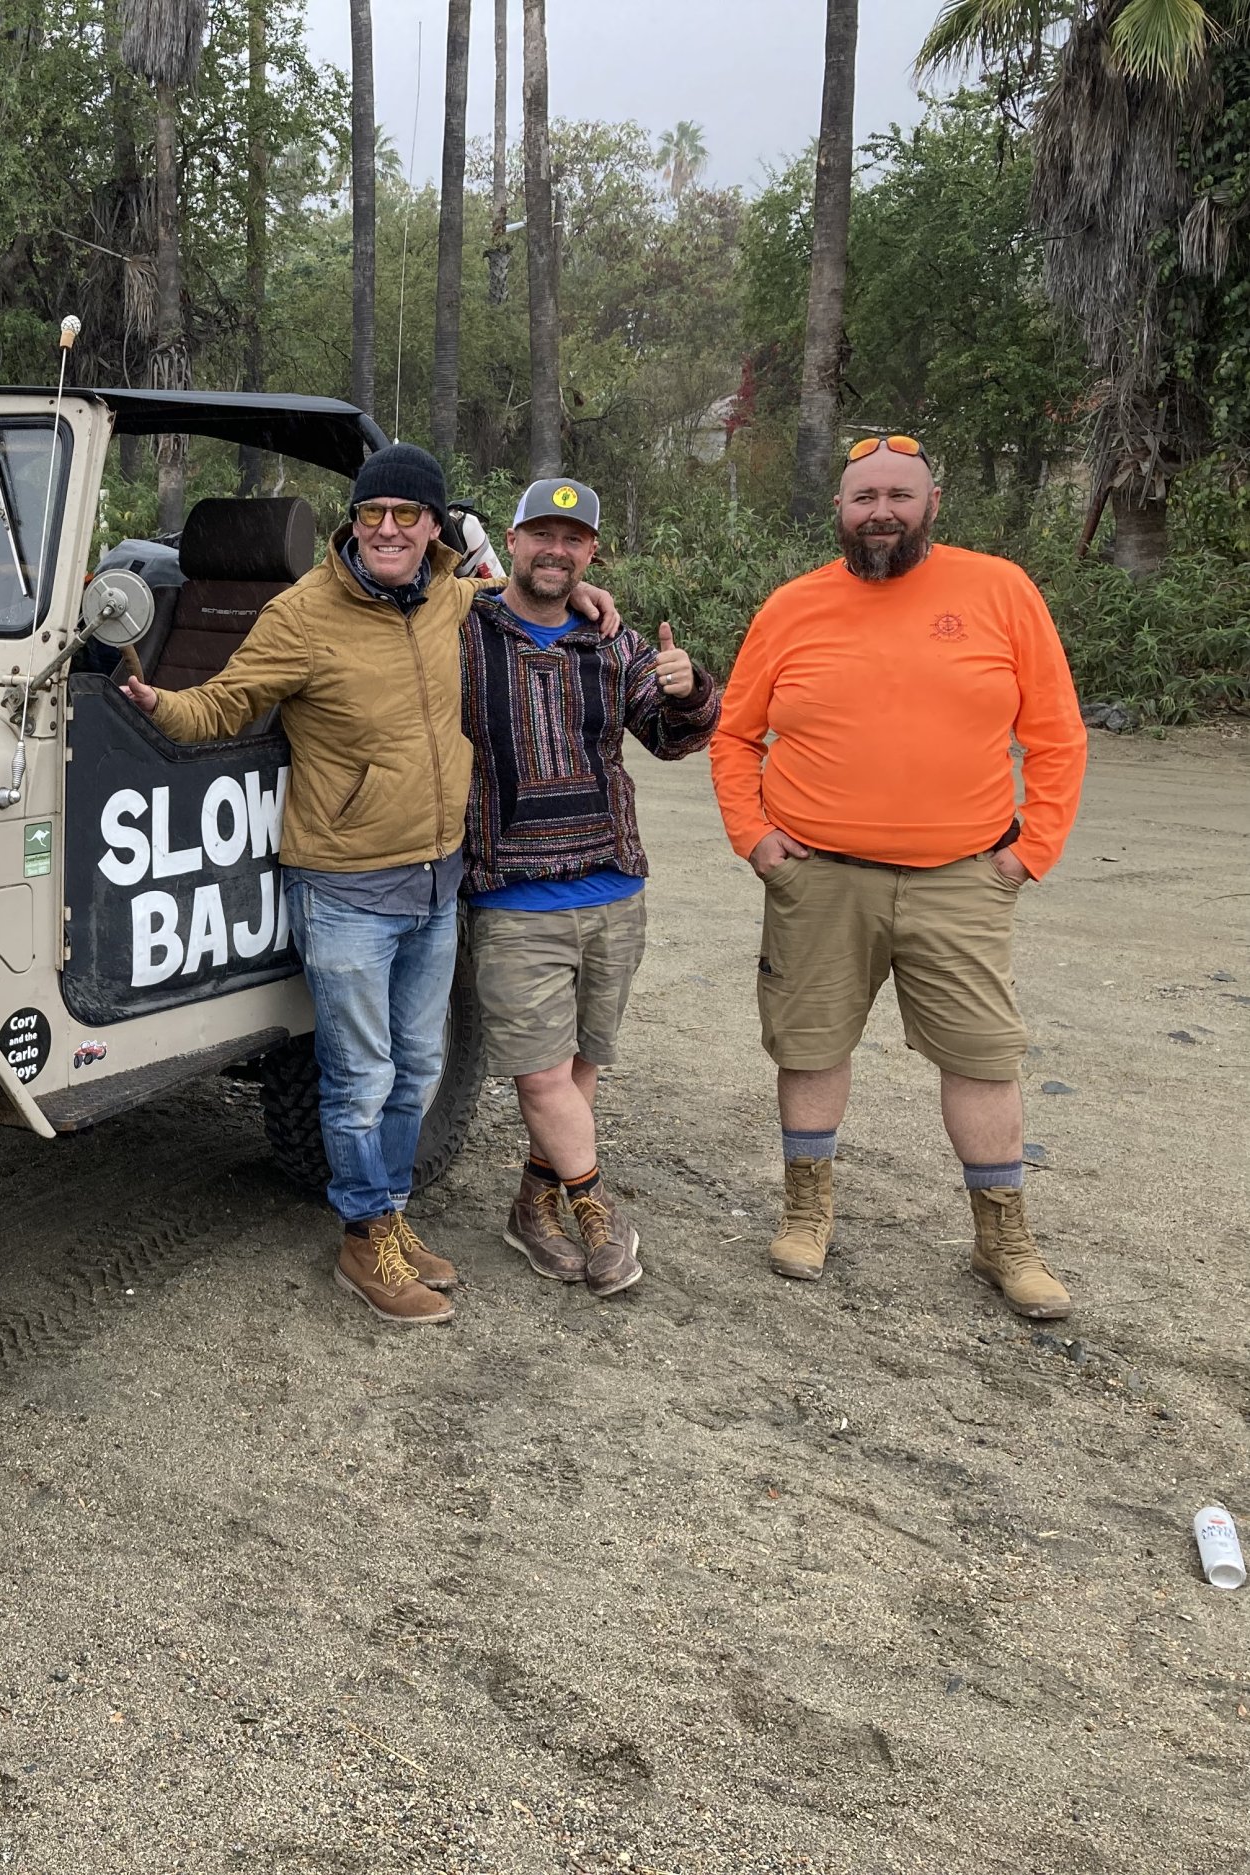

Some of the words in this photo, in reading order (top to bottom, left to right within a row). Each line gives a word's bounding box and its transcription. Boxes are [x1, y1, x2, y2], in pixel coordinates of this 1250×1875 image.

[97, 766, 291, 886] SLOW
[10, 1014, 38, 1030] Cory
[9, 1034, 24, 1046] and
[25, 1031, 38, 1042] the
[8, 1045, 39, 1064] Carlo
